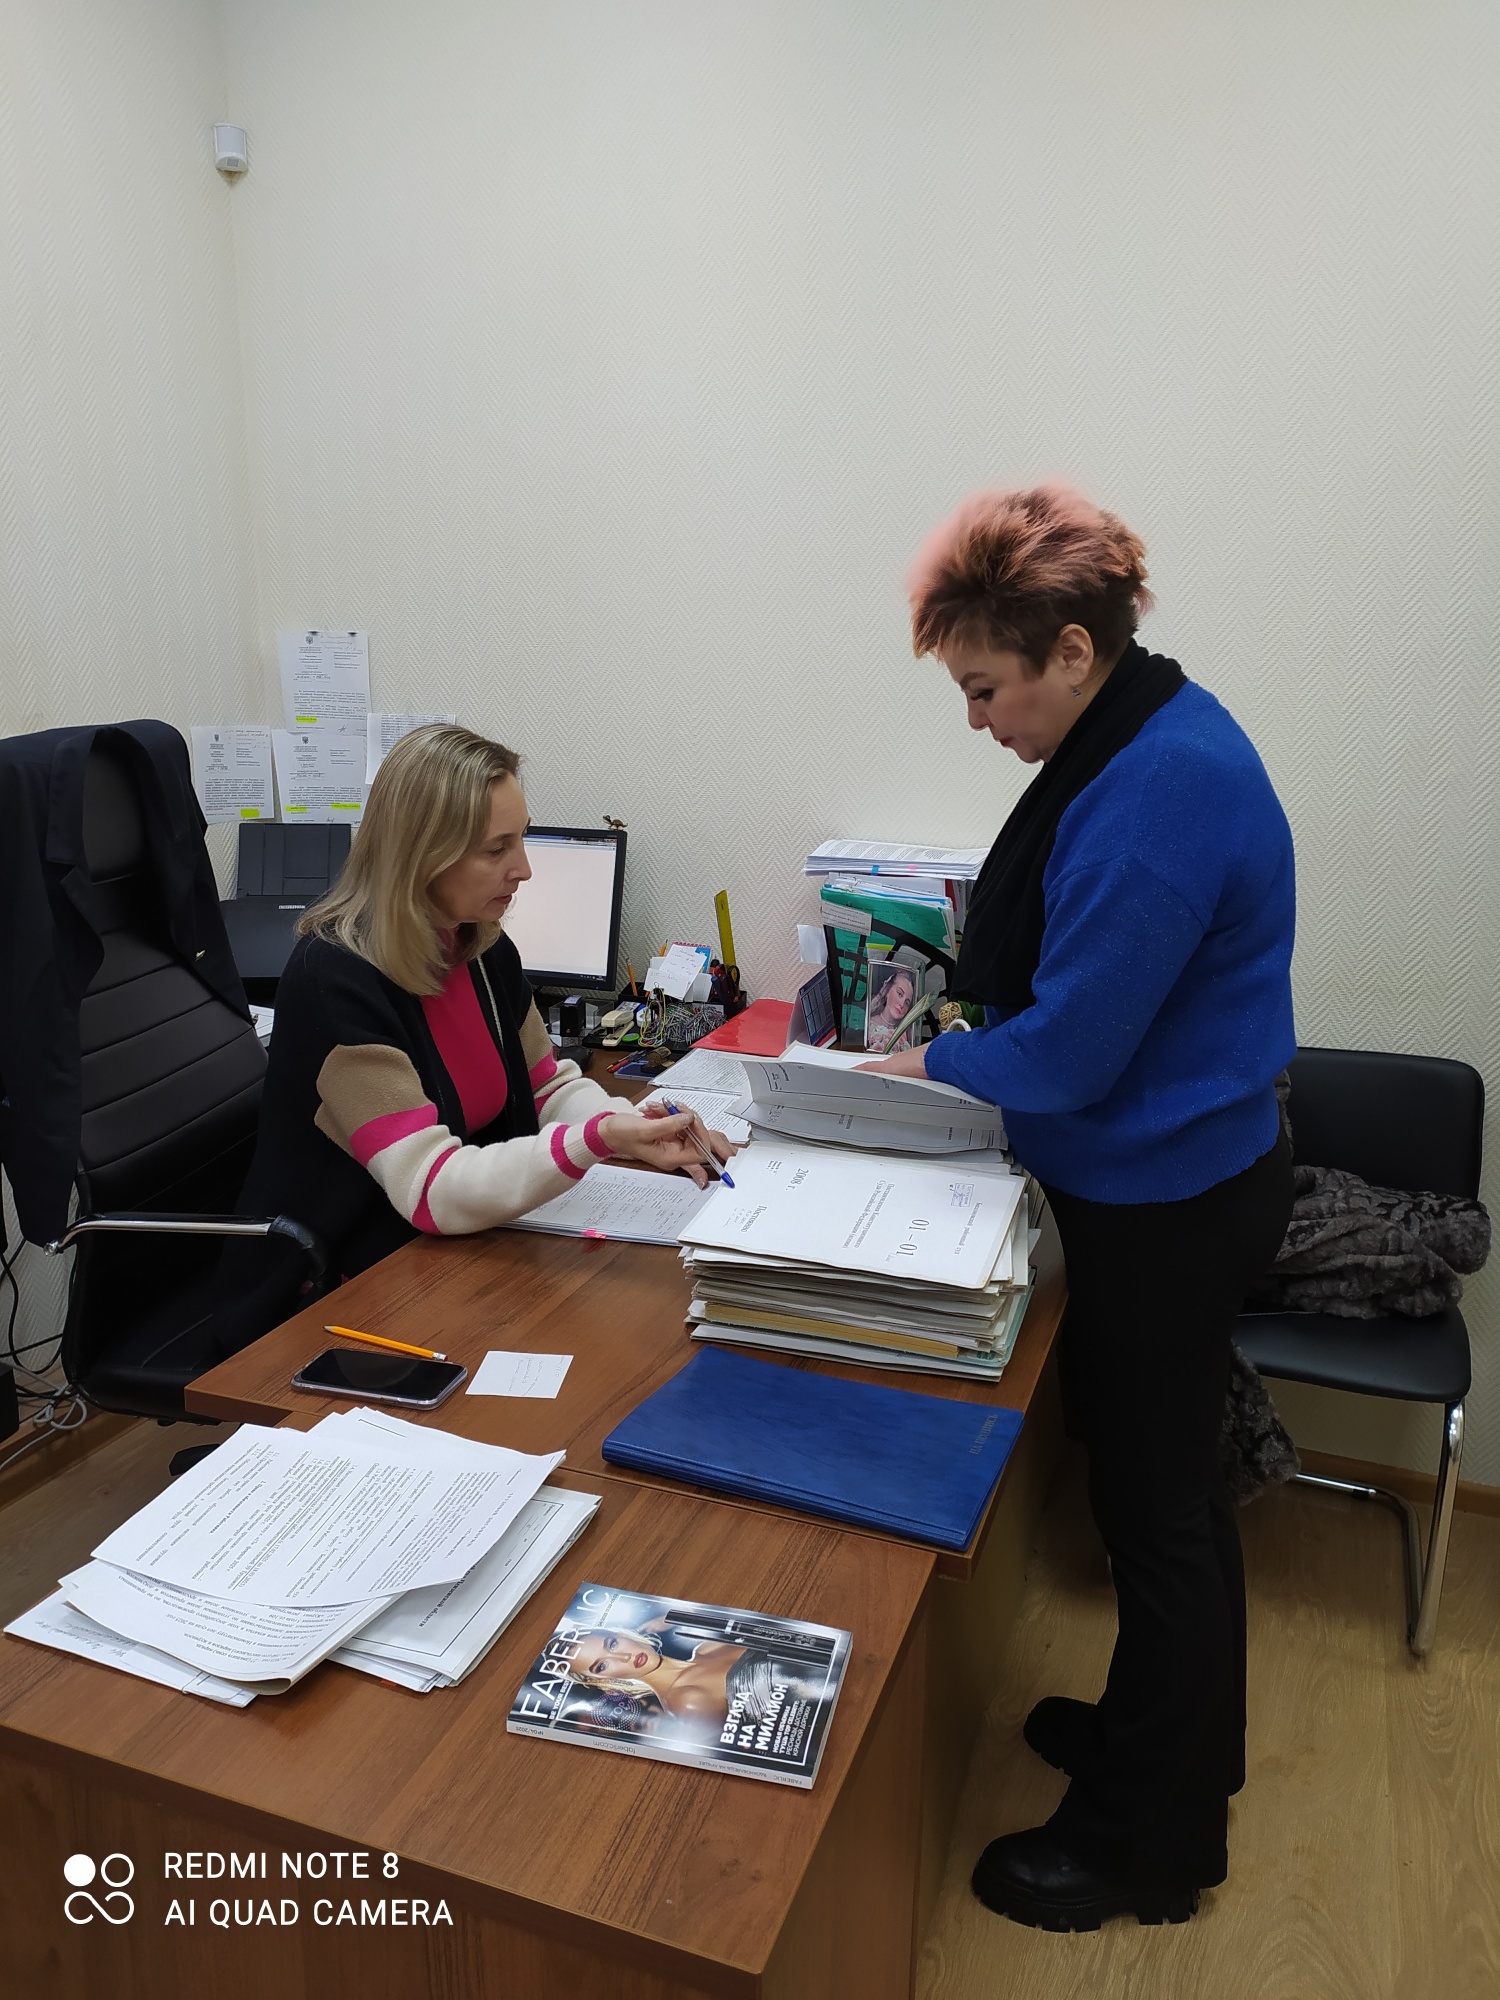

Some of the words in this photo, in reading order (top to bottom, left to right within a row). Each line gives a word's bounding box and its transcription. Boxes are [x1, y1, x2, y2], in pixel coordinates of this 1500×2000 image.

[790, 1167, 809, 1185] 2008
[740, 1205, 767, 1233] Постоянно
[908, 1218, 930, 1231] 01
[895, 1242, 918, 1256] 01
[974, 1413, 998, 1445] ПОДПИСЬ
[436, 1578, 466, 1608] Пензенской
[418, 1606, 439, 1628] области
[559, 1677, 571, 1694] BEST
[552, 1692, 564, 1710] YOUR
[607, 1702, 629, 1719] TOP
[548, 1710, 557, 1720] BE
[720, 1689, 751, 1744] ВЗГЛЯД
[755, 1681, 787, 1750] МИЛЛИОН
[737, 1724, 756, 1748] НА
[772, 1731, 783, 1753] НОВАЯ
[792, 1728, 804, 1757] КРАСНОЙ
[799, 1705, 811, 1729] ДОРОЖКИ
[778, 1735, 789, 1754] ТУШЬ
